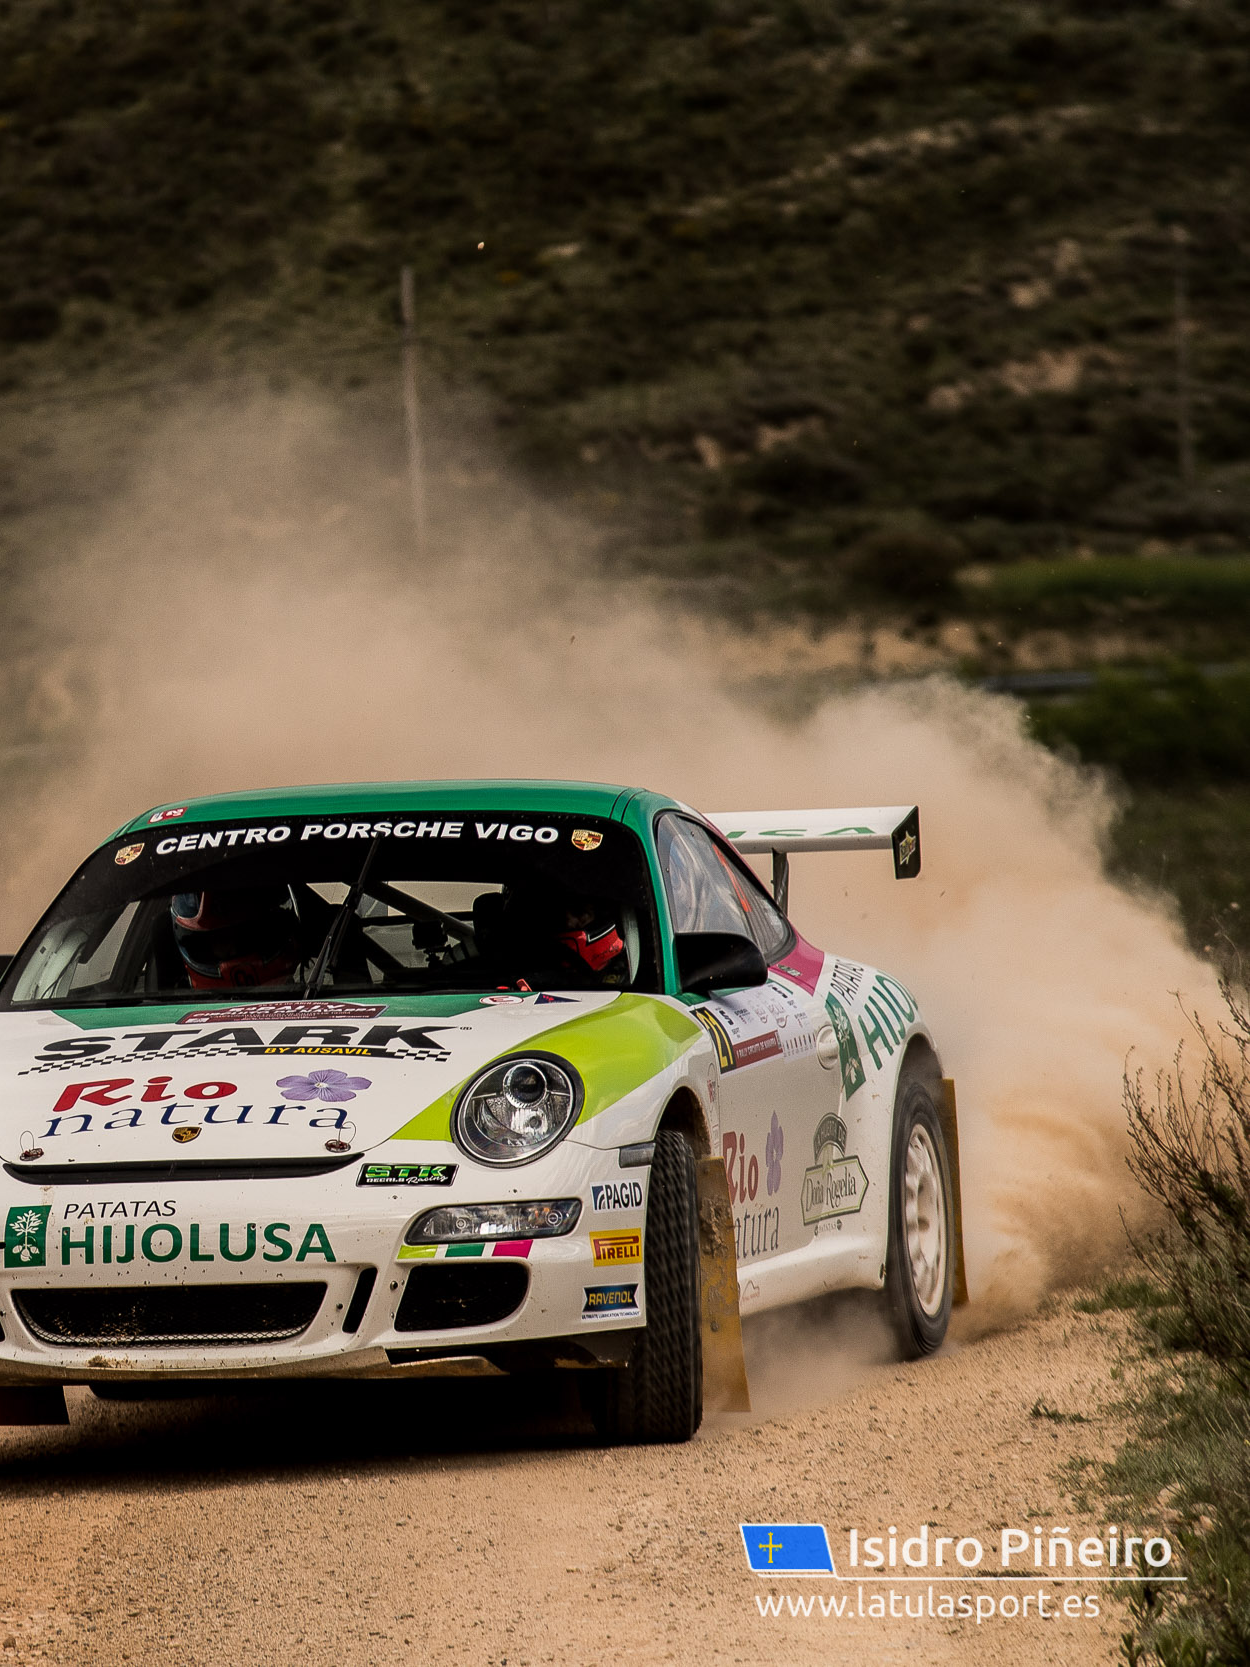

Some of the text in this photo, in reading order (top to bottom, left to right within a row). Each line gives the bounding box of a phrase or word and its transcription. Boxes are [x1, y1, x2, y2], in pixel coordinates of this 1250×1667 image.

[156, 822, 559, 855] CENTRO PORSCHE VIGO
[857, 971, 918, 1071] HIJO
[34, 1025, 459, 1062] STARK
[296, 1047, 372, 1055] AUSAVIL
[52, 1076, 238, 1112] Rio
[38, 1103, 351, 1138] natura
[365, 1165, 447, 1178] STK
[723, 1131, 759, 1205] Rio
[605, 1181, 642, 1210] PAGID
[825, 1167, 858, 1205] Rogelia
[63, 1200, 177, 1220] PATATAS
[61, 1222, 337, 1266] HIJOLUSA
[593, 1235, 640, 1260] PIRELLI
[734, 1205, 779, 1260] atura
[588, 1290, 633, 1305] RAVENOL
